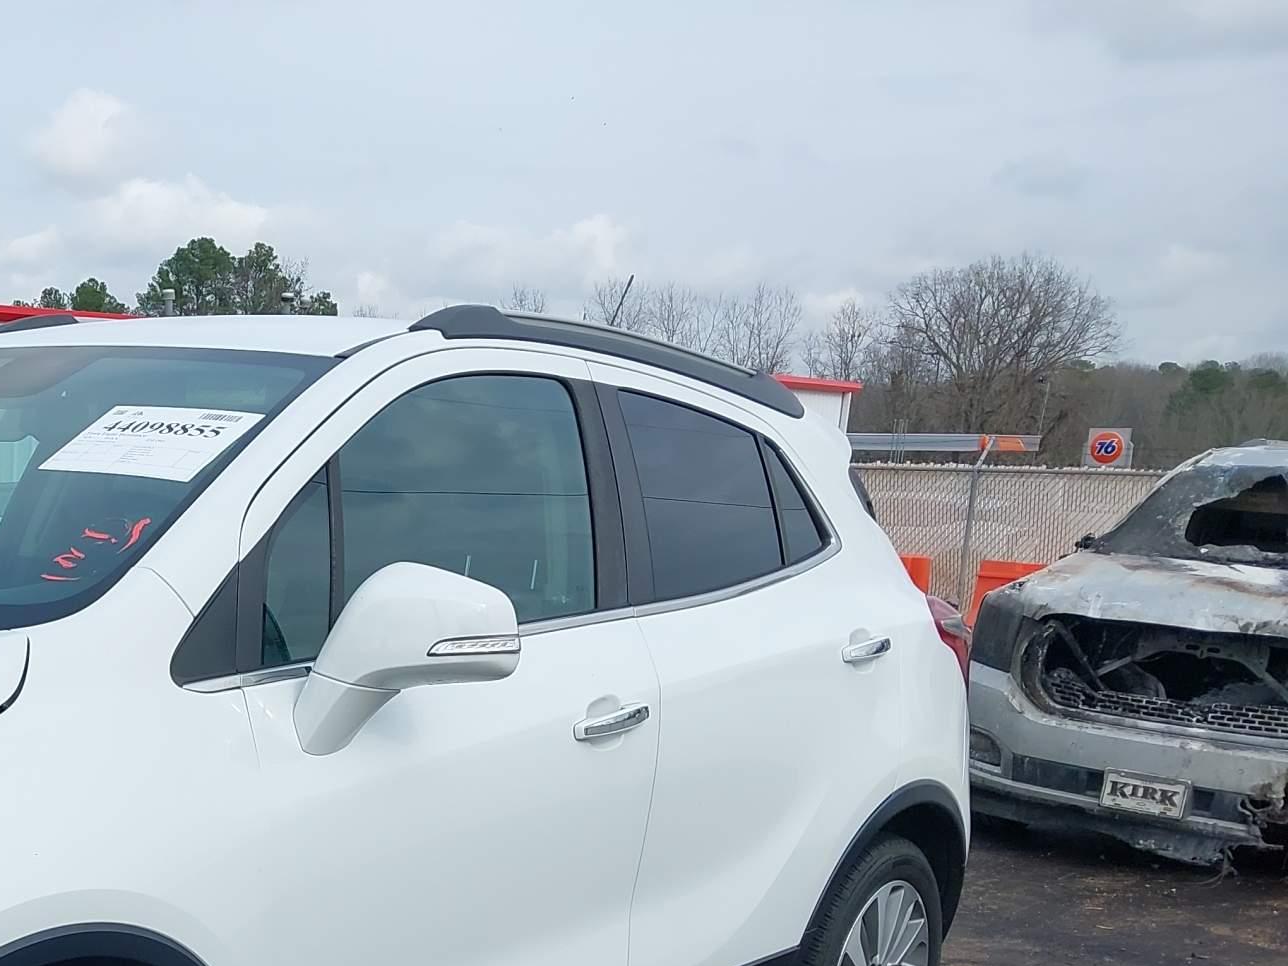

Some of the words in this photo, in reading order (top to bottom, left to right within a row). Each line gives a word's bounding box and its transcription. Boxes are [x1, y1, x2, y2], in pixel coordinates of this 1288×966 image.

[104, 420, 229, 438] 44098855
[1094, 438, 1120, 456] 76
[1106, 780, 1180, 808] KIRK
